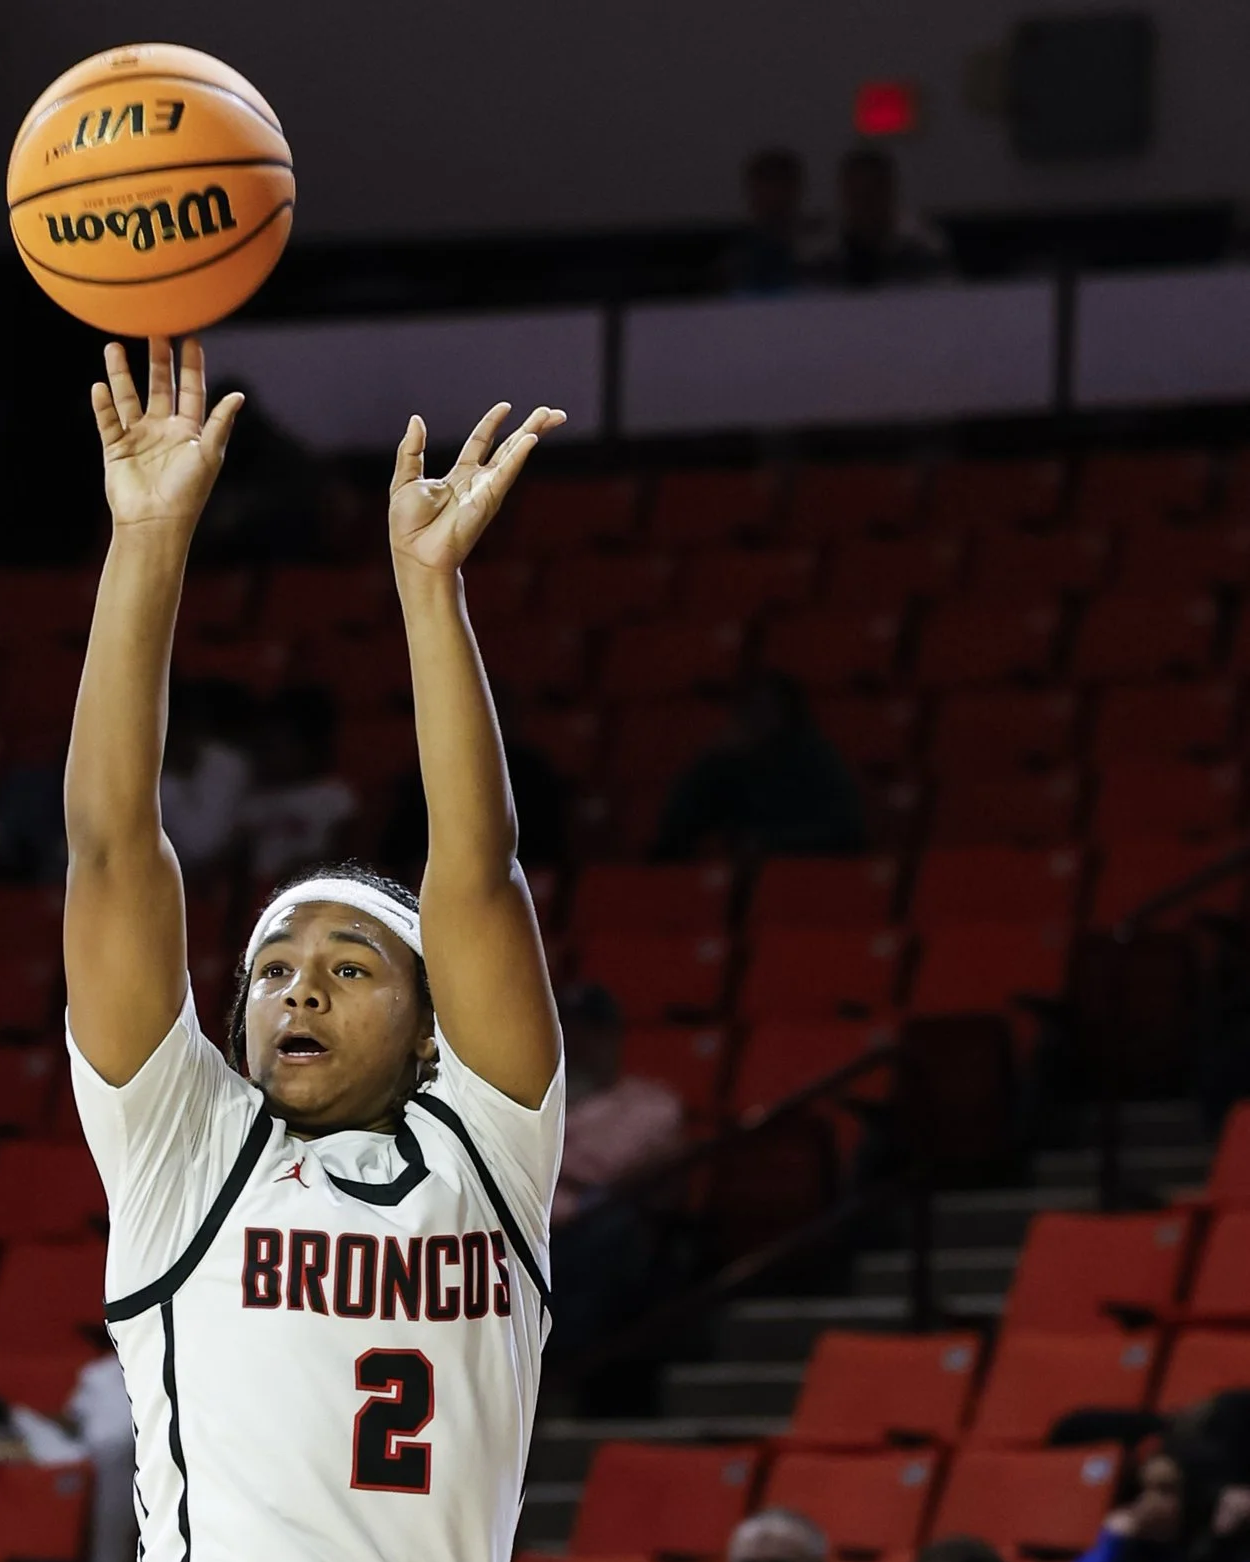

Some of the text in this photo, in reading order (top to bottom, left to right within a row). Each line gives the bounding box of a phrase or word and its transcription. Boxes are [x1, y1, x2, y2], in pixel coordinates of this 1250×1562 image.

[45, 184, 238, 252] Wilson
[241, 1226, 511, 1322] BRONCOS
[350, 1347, 435, 1495] 2
